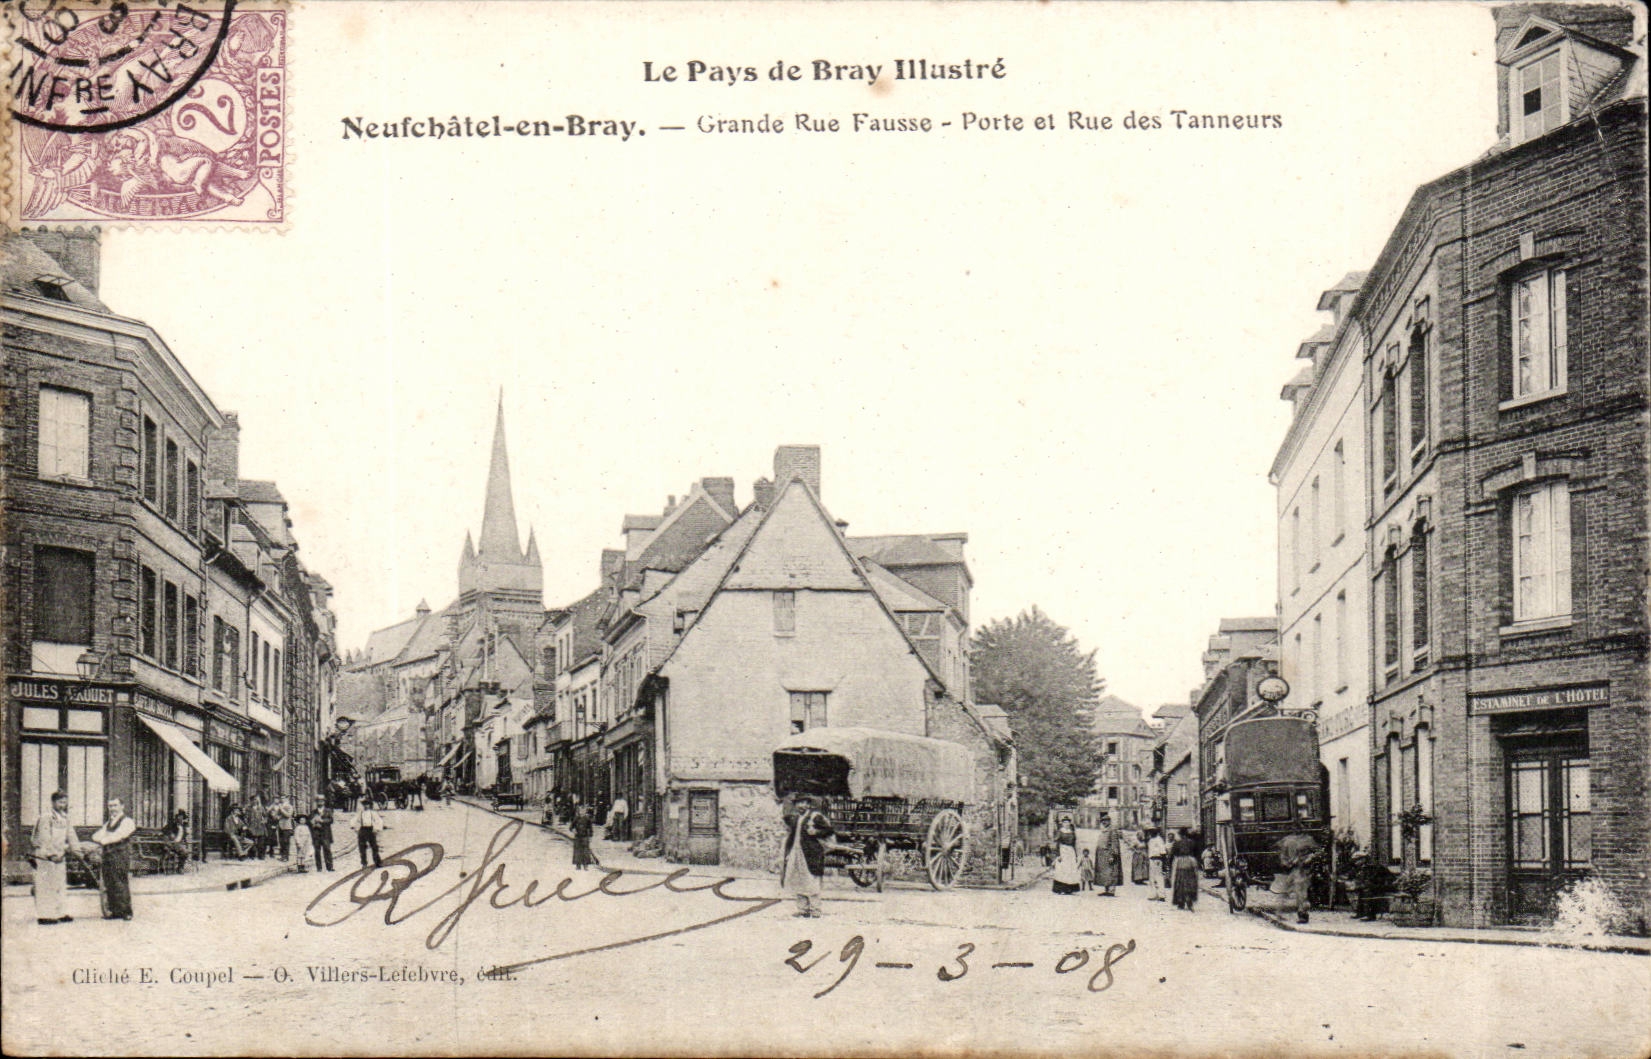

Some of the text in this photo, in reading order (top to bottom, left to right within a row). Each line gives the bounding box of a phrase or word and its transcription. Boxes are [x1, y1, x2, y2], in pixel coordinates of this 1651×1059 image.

[259, 71, 282, 164] POSTES
[11, 682, 59, 700] JULES
[1472, 694, 1532, 711] ESTAMINET
